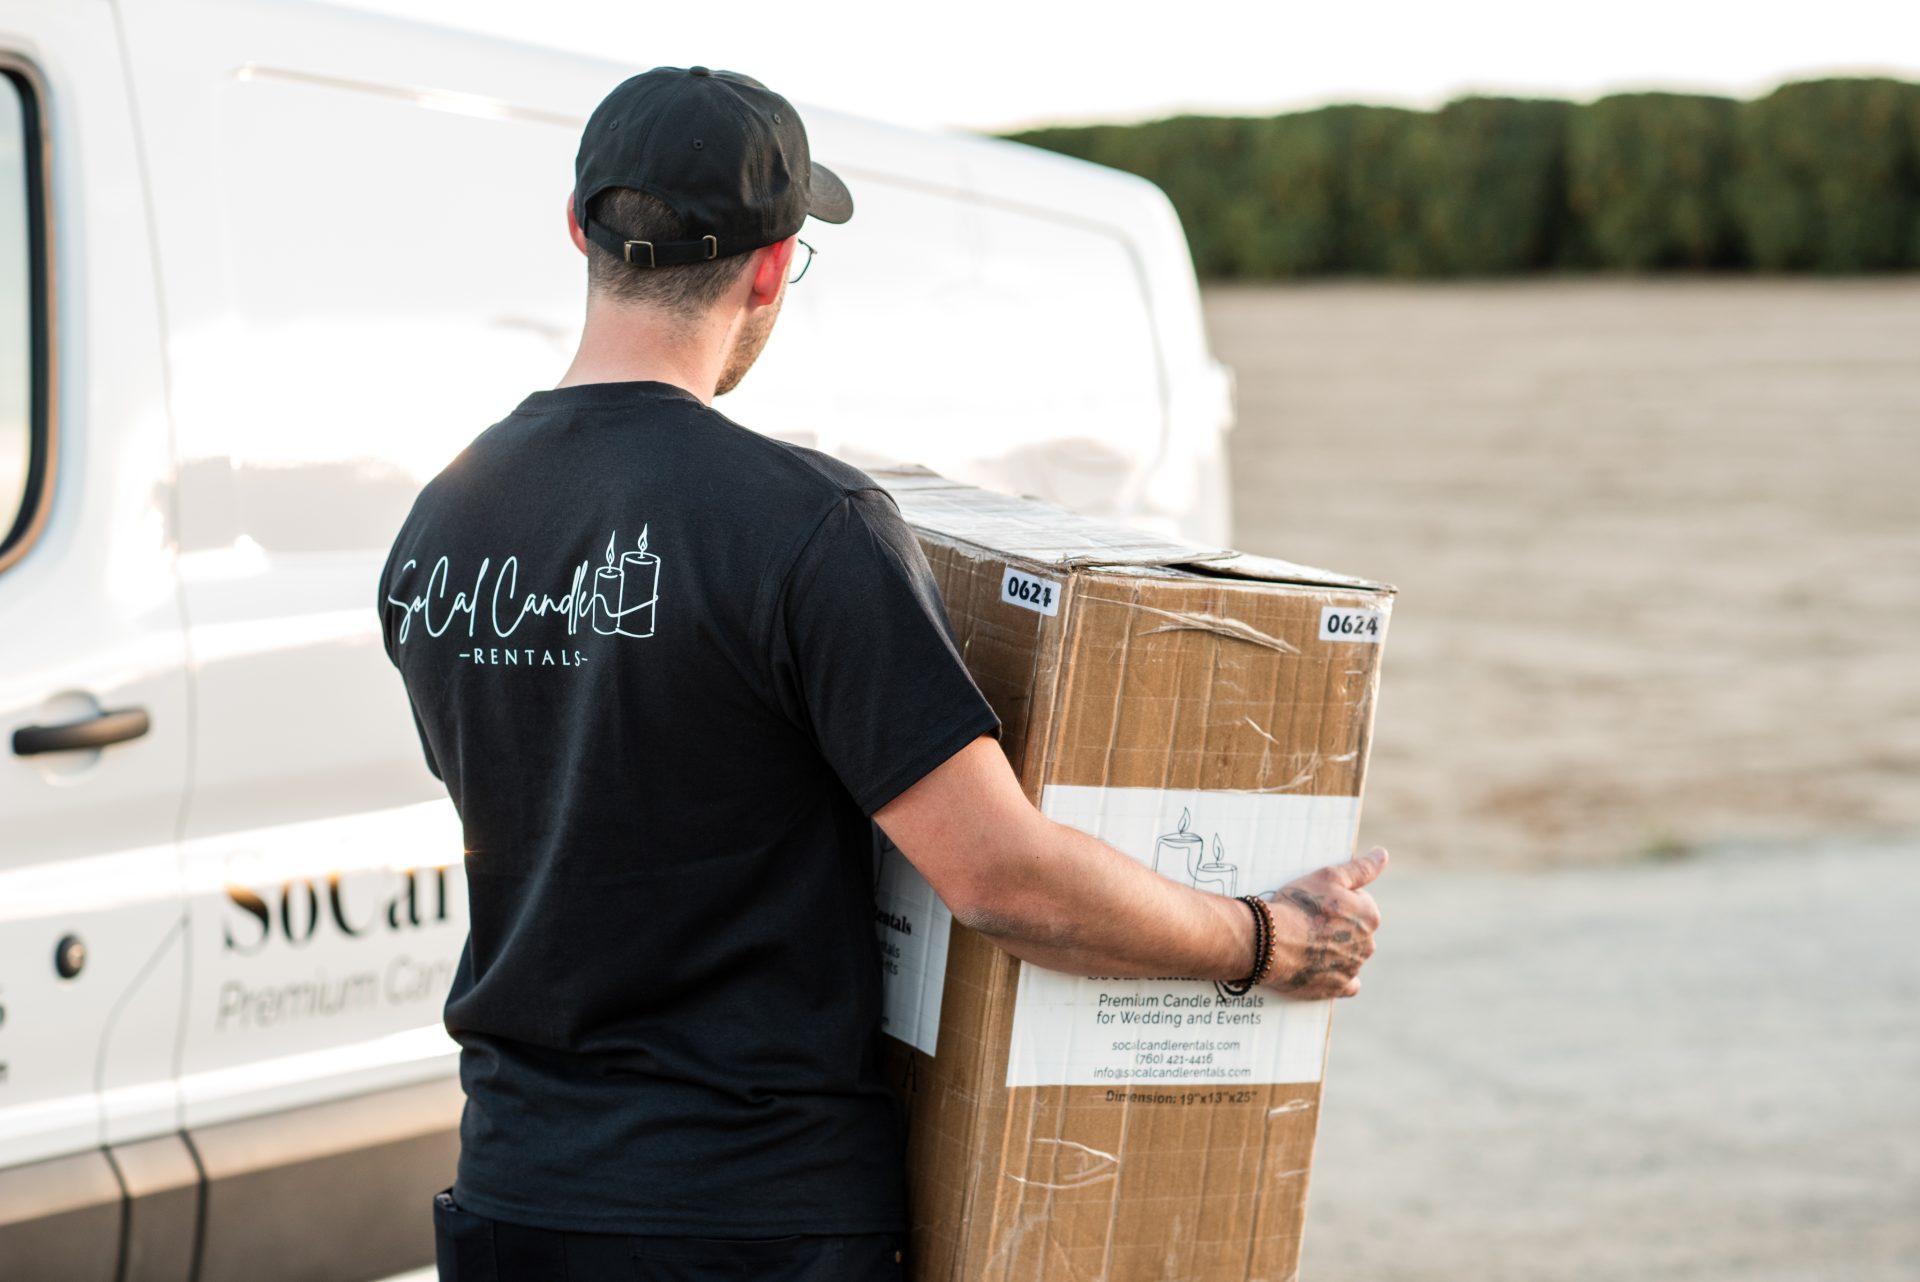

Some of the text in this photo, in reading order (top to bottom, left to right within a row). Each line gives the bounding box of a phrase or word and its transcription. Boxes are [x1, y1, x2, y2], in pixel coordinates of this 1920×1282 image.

[388, 555, 489, 645] SoCal
[1007, 576, 1052, 608] 0624
[1327, 614, 1379, 636] 0624
[214, 966, 379, 1033] Premium
[1098, 993, 1264, 1008] Premium Candle Rentals
[1096, 1011, 1262, 1028] for Wedding and Events
[1135, 1053, 1213, 1066] (760) 421-4416
